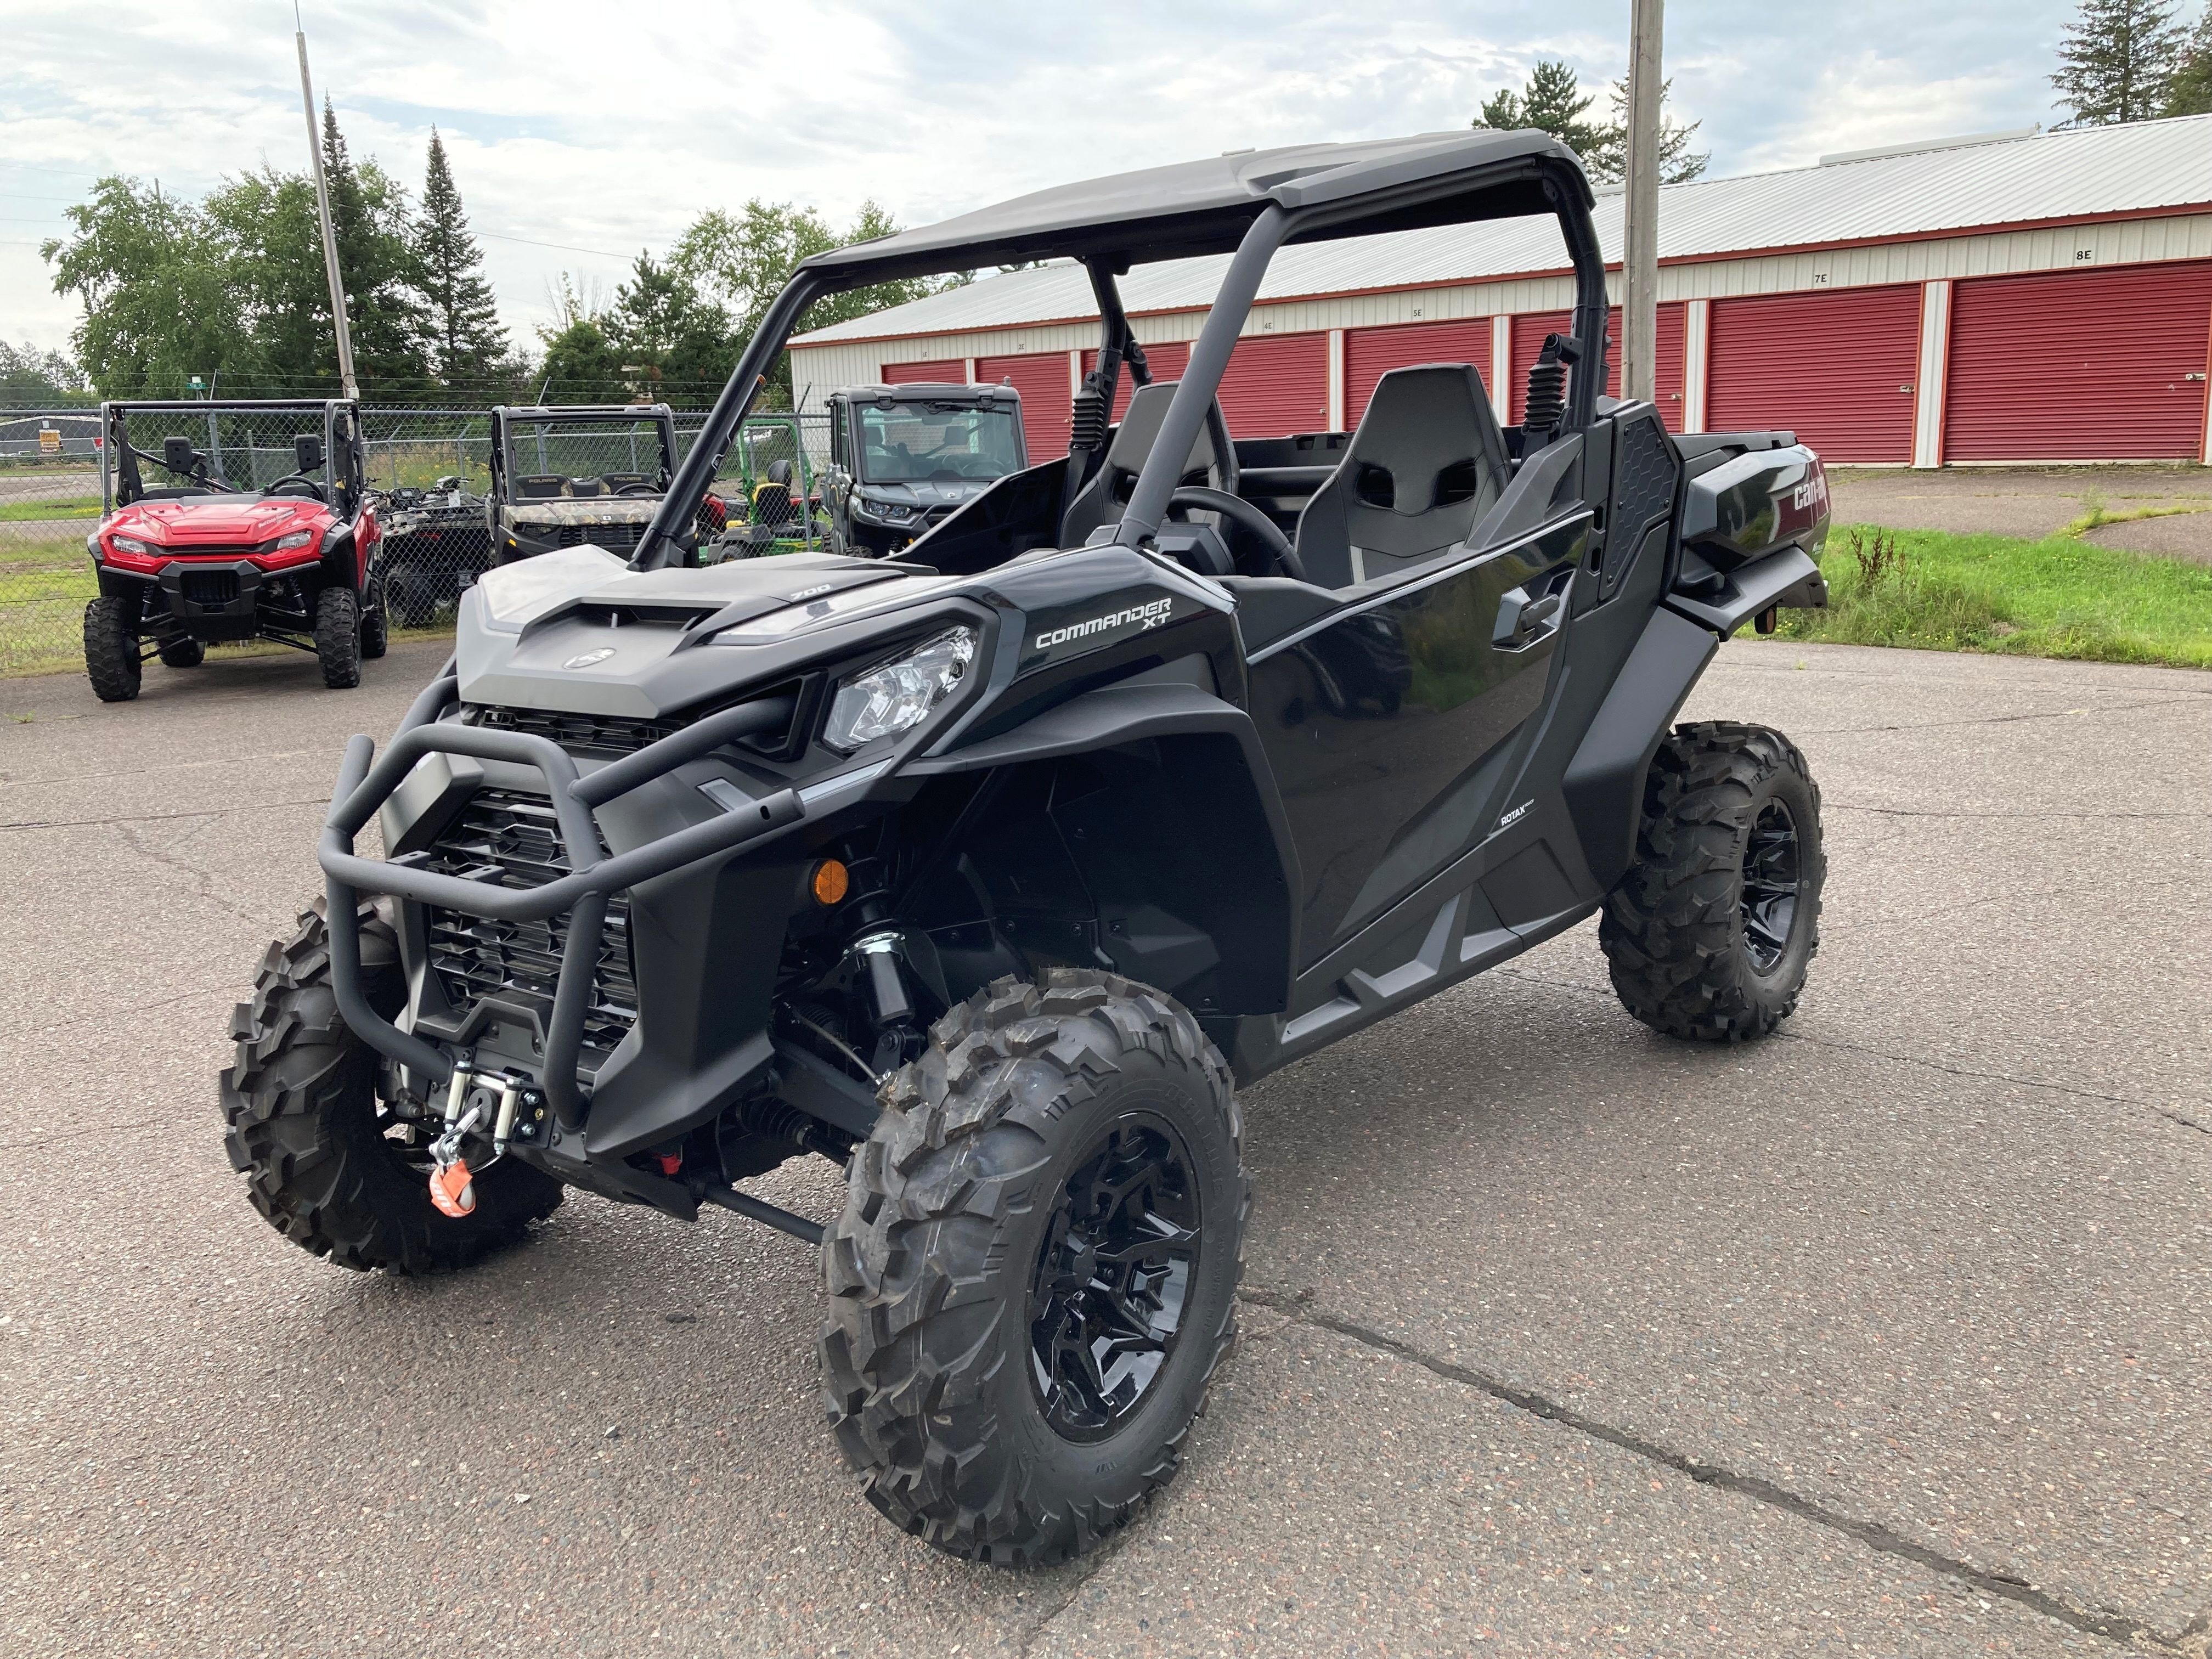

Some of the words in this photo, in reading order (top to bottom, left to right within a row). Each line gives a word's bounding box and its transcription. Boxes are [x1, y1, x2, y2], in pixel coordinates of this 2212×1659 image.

[2076, 250, 2091, 260] 8E
[1815, 274, 1827, 283] 7E
[791, 584, 831, 600] 700
[1036, 597, 1172, 649] COMMANDER
[1142, 612, 1171, 630] XT
[1501, 805, 1526, 826] ROTAX
